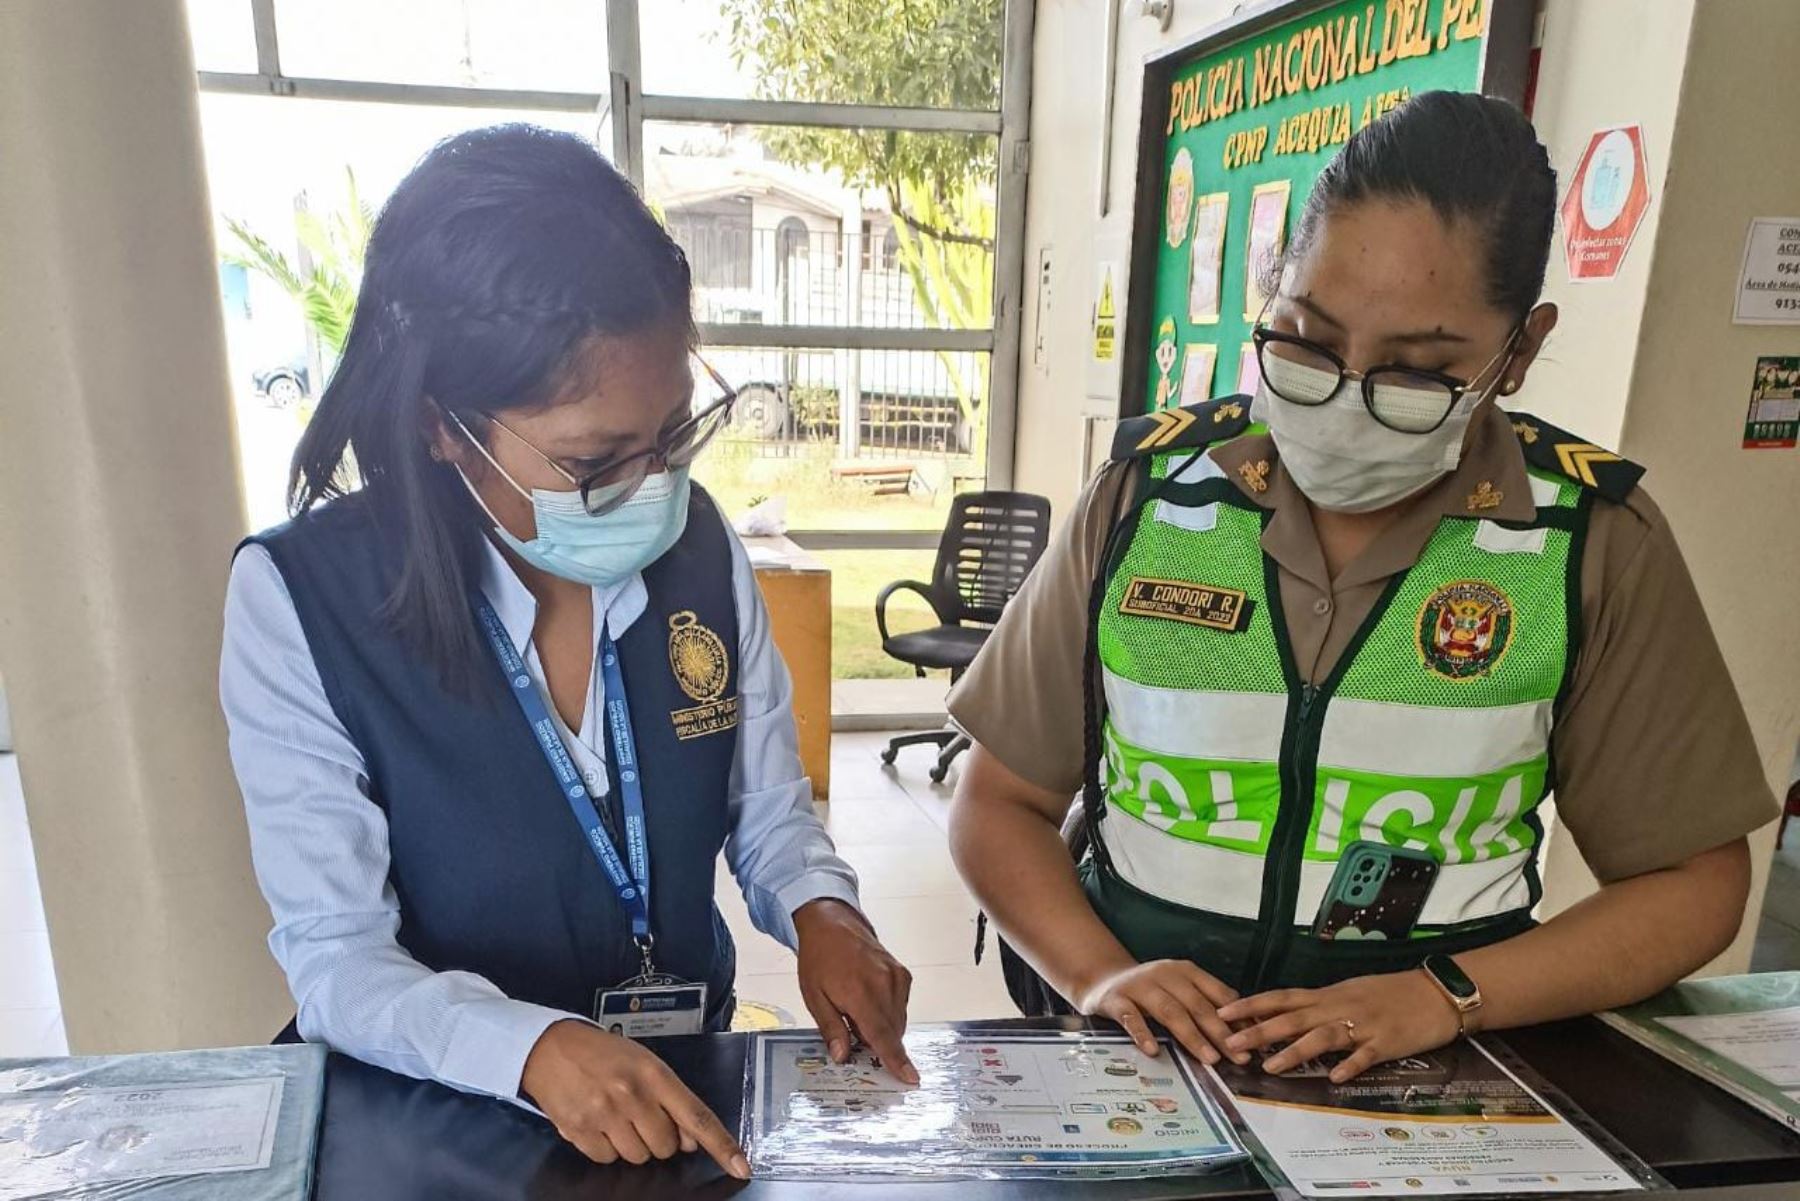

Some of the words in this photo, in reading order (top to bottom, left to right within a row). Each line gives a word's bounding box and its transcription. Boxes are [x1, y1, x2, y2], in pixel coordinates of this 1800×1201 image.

[1167, 57, 1244, 135] POLICIA
[1251, 5, 1376, 109] NACIONAL
[1378, 0, 1431, 65] DEL
[1223, 126, 1267, 169] CPNP
[1273, 102, 1350, 155] ACEQUIA
[1152, 585, 1214, 608] CONDORI
[1221, 595, 1234, 612] R.
